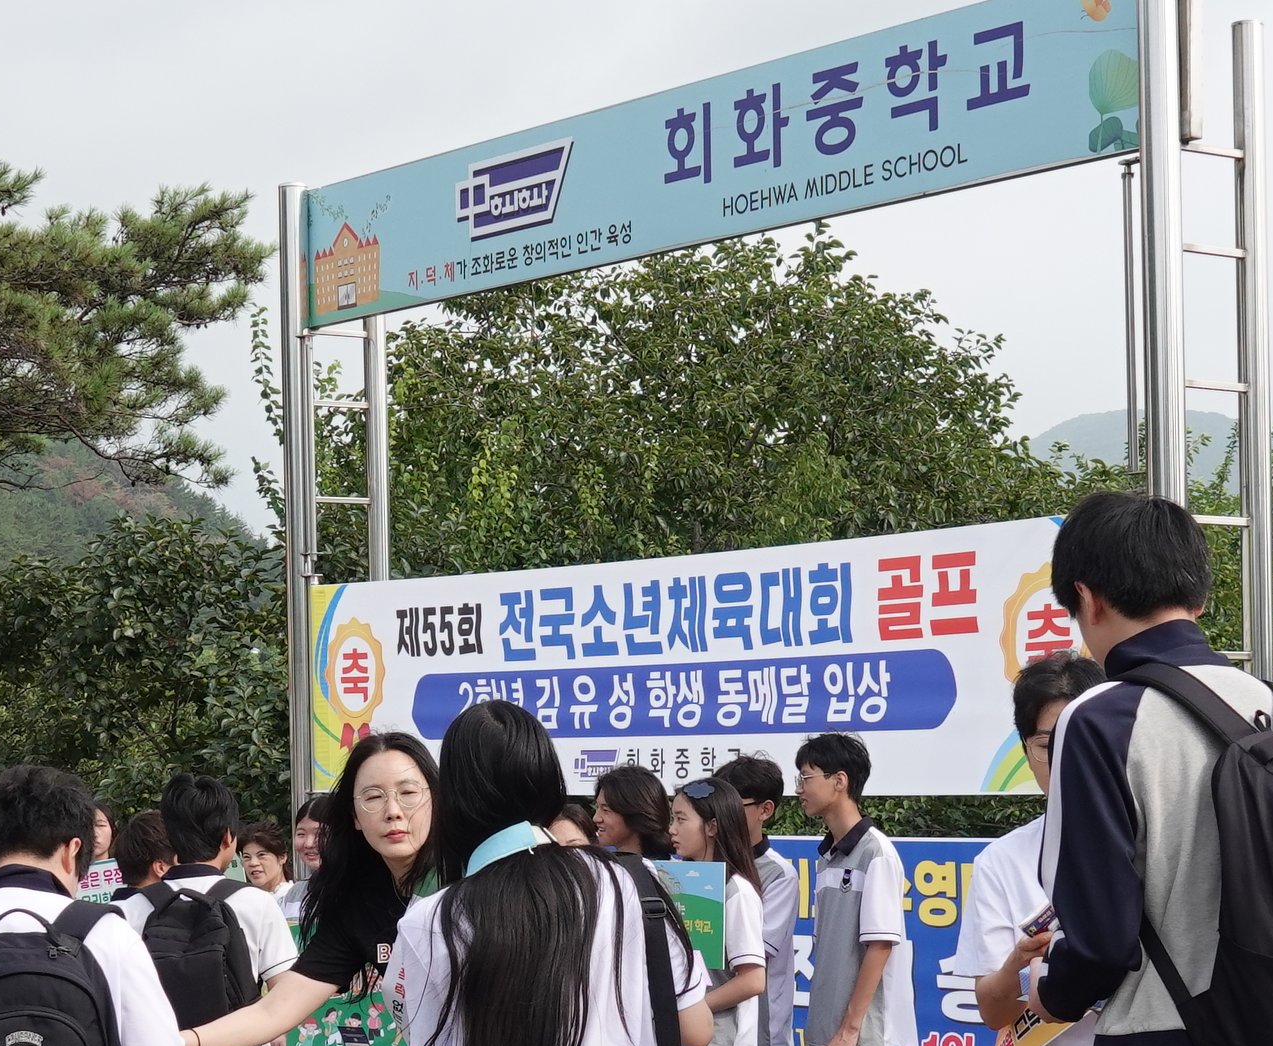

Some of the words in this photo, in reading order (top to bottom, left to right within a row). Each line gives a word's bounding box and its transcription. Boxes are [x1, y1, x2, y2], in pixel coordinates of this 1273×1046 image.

[664, 21, 1030, 184] 회화중학교
[723, 182, 798, 217] HOEHWA
[804, 163, 874, 202] MIDDLE
[881, 143, 968, 182] SCHOOL
[470, 242, 519, 277] 조화로운
[522, 233, 572, 268] 창의적인
[576, 227, 603, 254] 인간
[606, 220, 633, 245] 육성
[396, 603, 483, 657] 제55회
[499, 562, 852, 662] 전국소년체육대회
[878, 551, 979, 641] 골프
[340, 648, 370, 703] 축
[646, 670, 705, 728] 학생
[717, 664, 811, 727] 동메달
[823, 660, 891, 723] 입상
